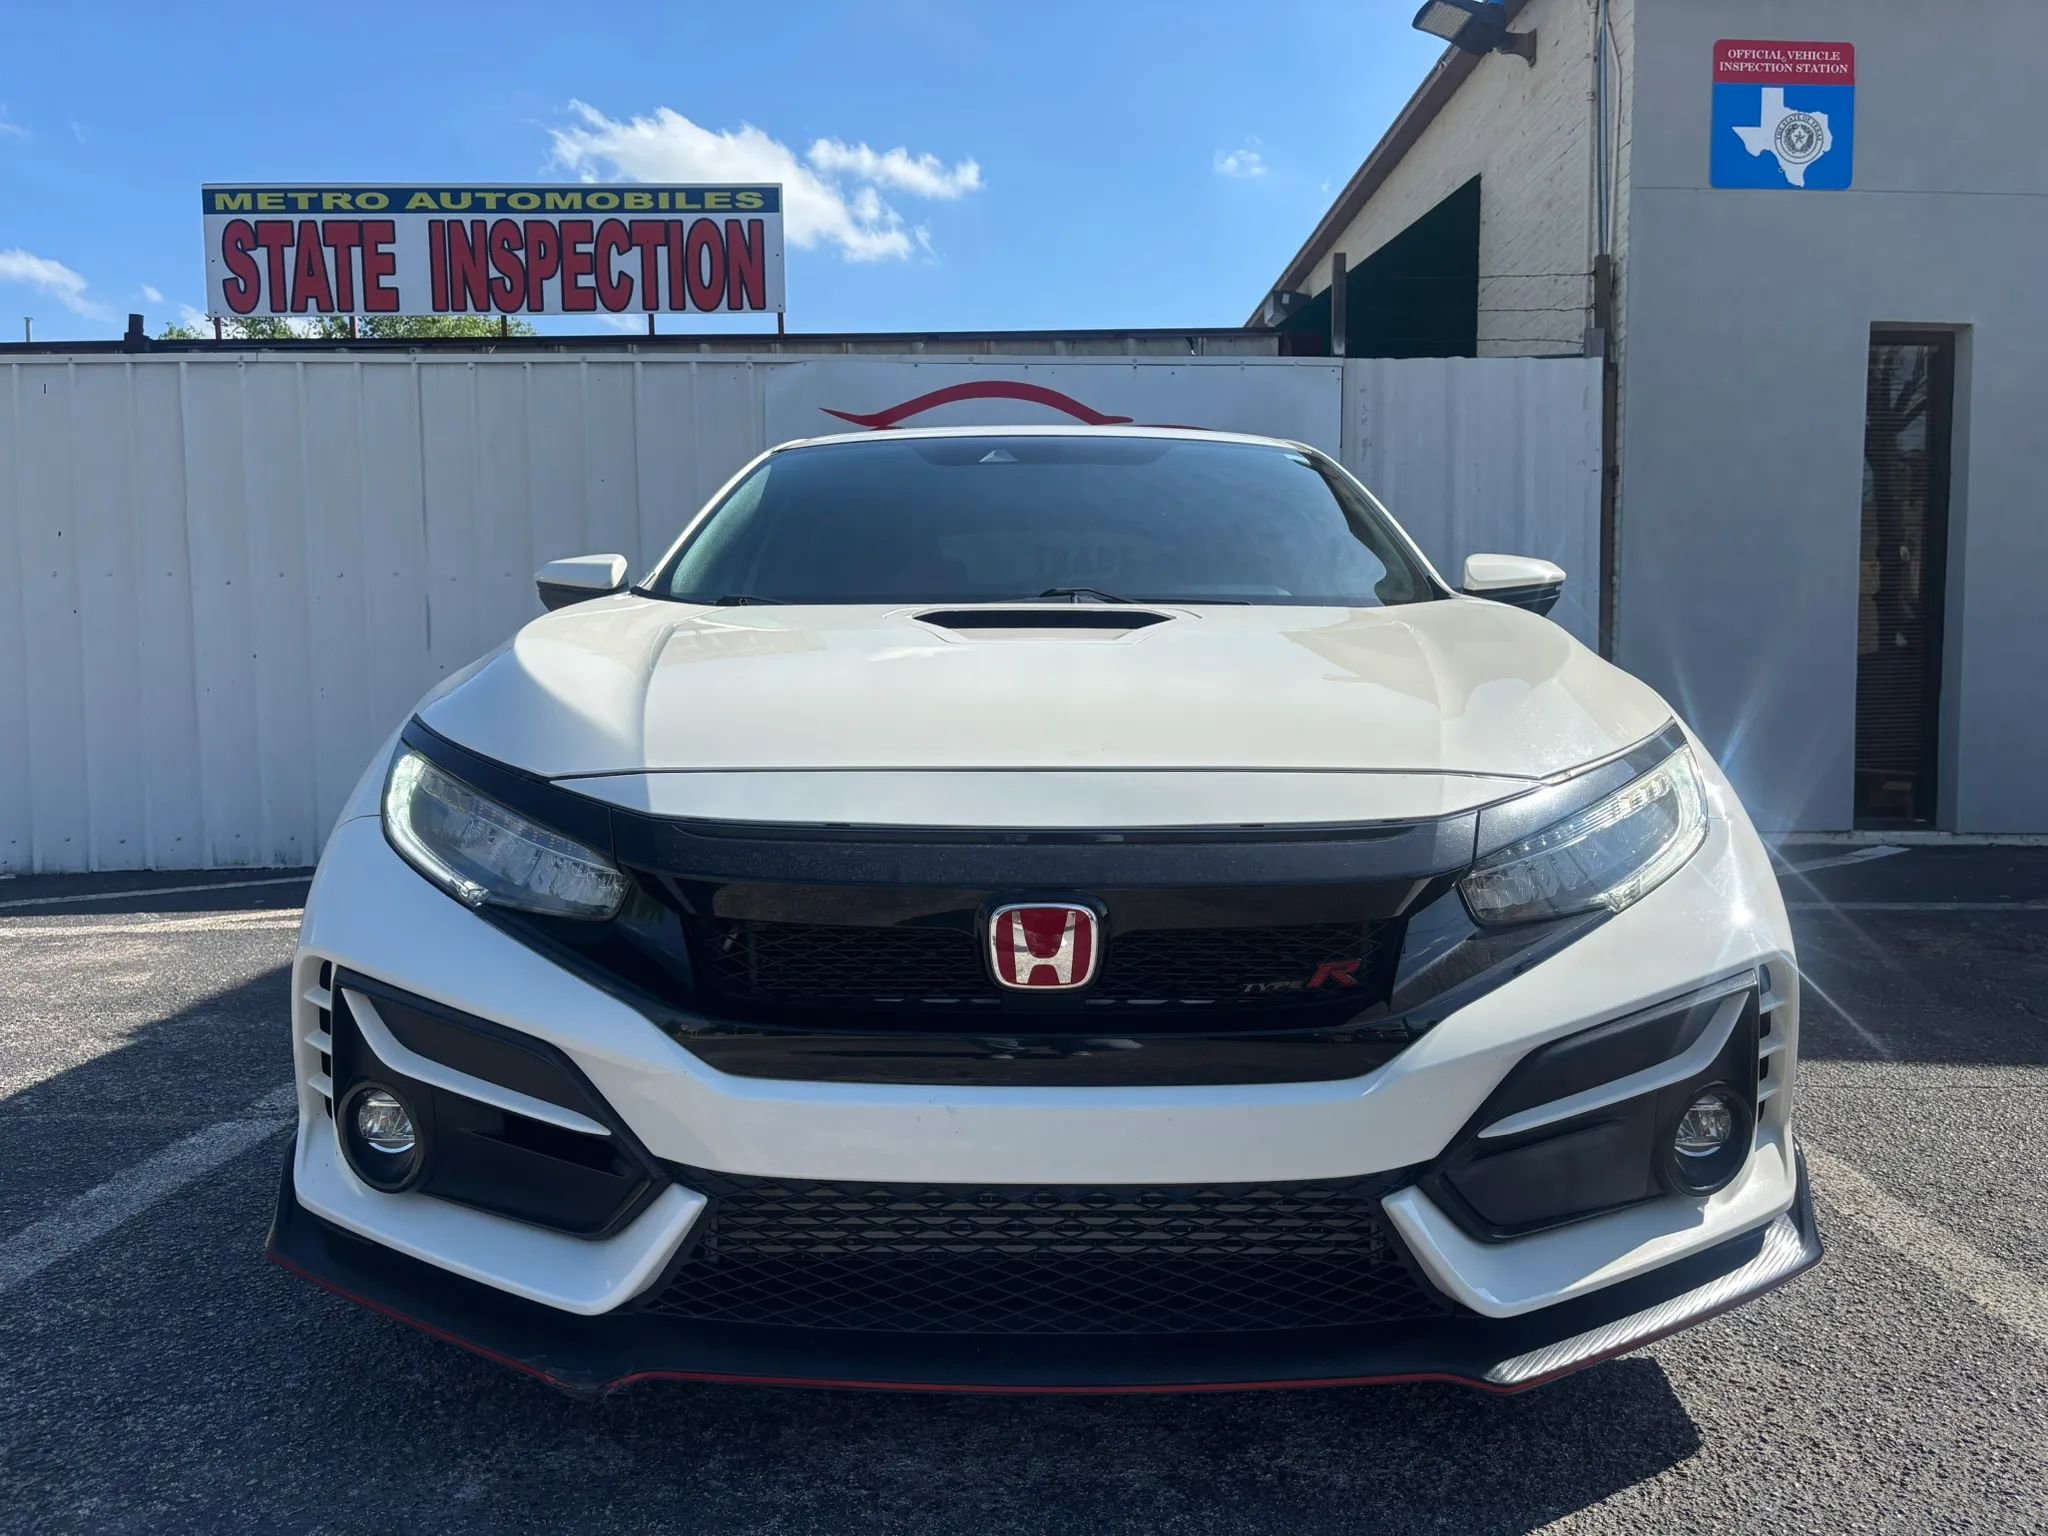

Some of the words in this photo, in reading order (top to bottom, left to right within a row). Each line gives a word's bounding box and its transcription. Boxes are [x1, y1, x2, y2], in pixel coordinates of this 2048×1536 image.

[1728, 49, 1783, 60] OFFICIAL
[1787, 50, 1841, 61] VEHICLE
[1719, 62, 1793, 73] INSPECTION
[1796, 63, 1848, 73] STATION
[214, 191, 390, 210] METRO
[403, 191, 765, 211] AUTOMOBILES
[221, 218, 400, 314] STATE
[428, 217, 767, 313] INSPECTION
[1306, 959, 1362, 989] R
